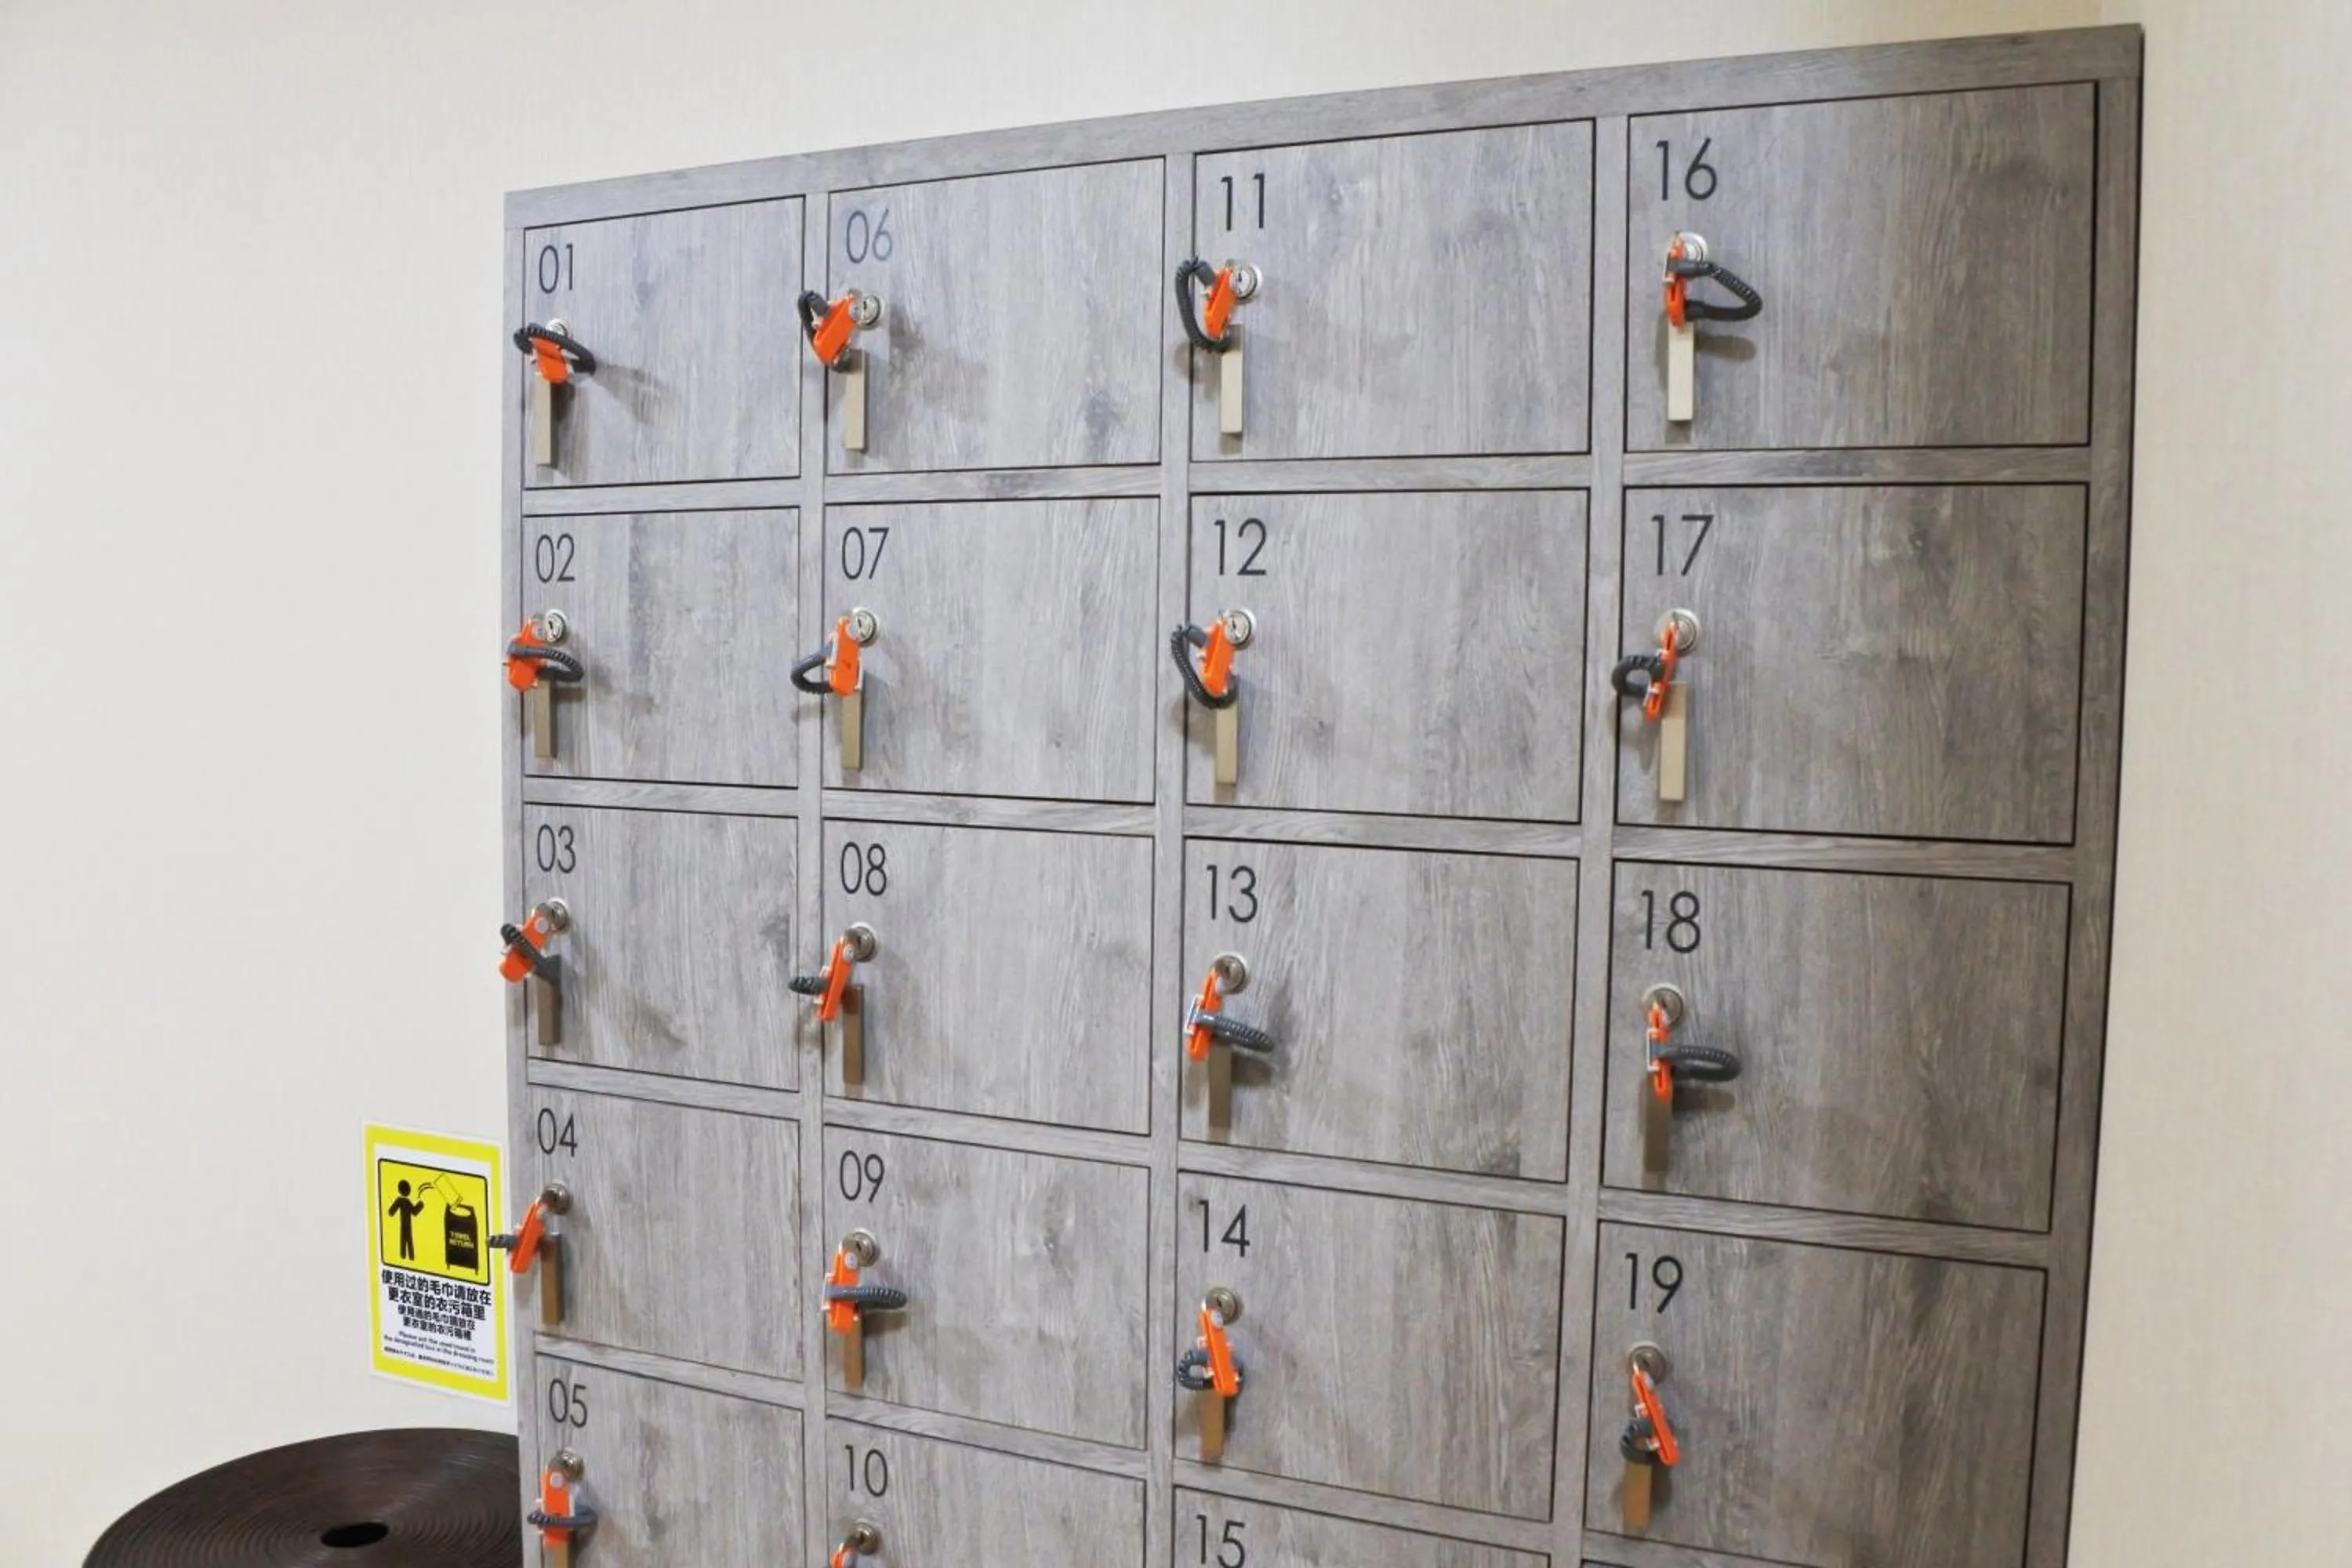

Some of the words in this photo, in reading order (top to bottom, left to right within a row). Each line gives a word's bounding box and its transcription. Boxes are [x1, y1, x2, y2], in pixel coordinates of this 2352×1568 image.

[1656, 137, 1718, 201] 16
[1221, 173, 1265, 230] 11
[845, 209, 892, 263] 06
[539, 244, 573, 293] 01
[535, 533, 575, 583] 02
[841, 527, 889, 579] 07
[1214, 517, 1267, 575] 12
[1650, 514, 1715, 575] 17
[536, 824, 575, 873] 03
[840, 842, 887, 895] 08
[1206, 865, 1258, 923] 13
[1641, 890, 1701, 953] 18
[537, 1108, 577, 1157] 04
[839, 1150, 884, 1203] 09
[1198, 1200, 1250, 1257] 14
[382, 1269, 492, 1305] 使用过的毛巾请放在
[1624, 1252, 1683, 1314] 19
[549, 1378, 587, 1428] 05
[844, 1445, 887, 1497] 10
[1196, 1515, 1246, 1568] 15
